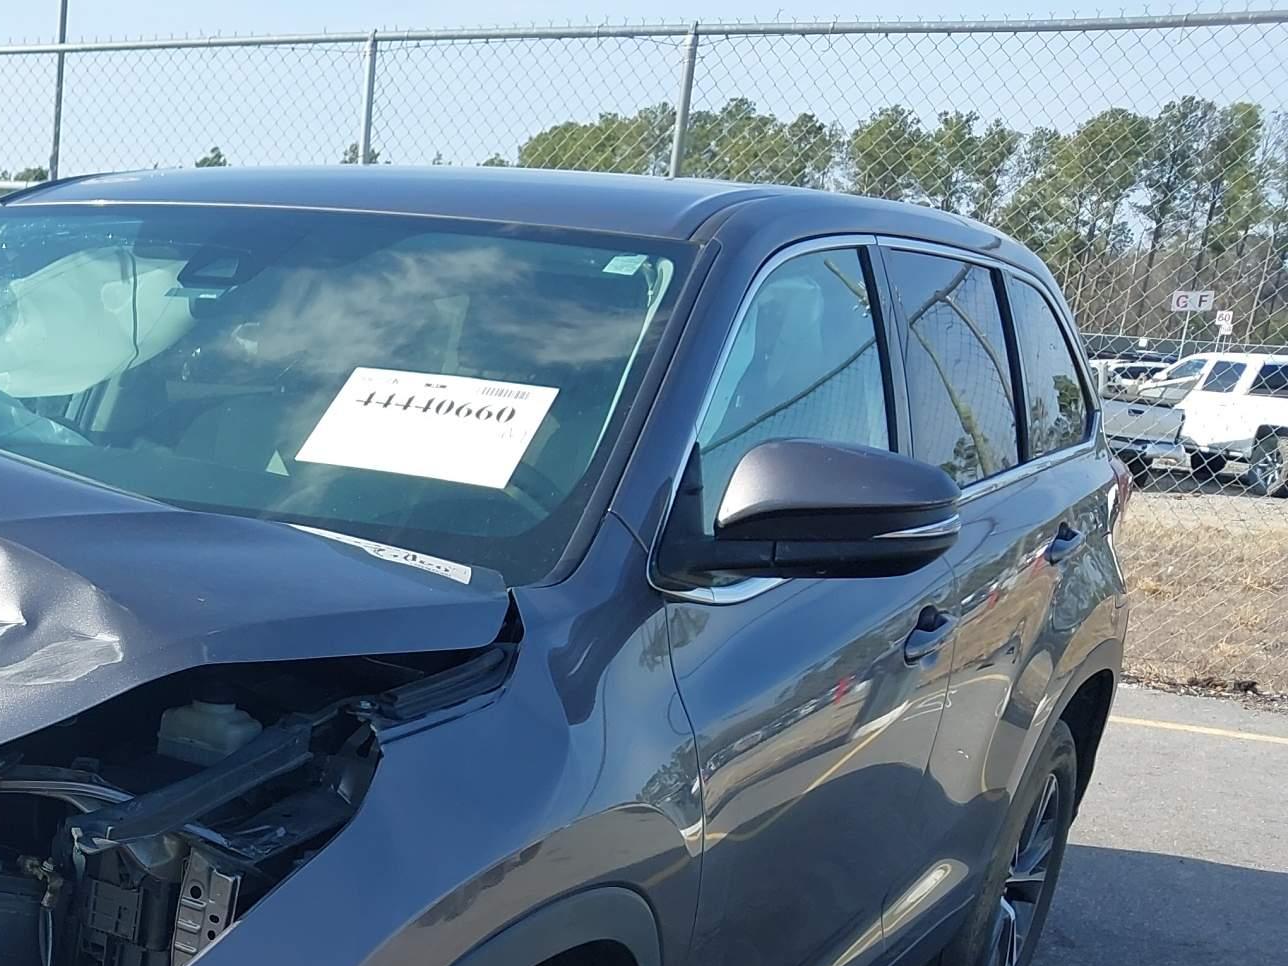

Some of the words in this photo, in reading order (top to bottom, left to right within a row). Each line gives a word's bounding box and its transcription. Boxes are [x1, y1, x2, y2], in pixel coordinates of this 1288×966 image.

[1176, 294, 1189, 308] G
[1198, 294, 1209, 308] F
[355, 390, 517, 424] 44440660
